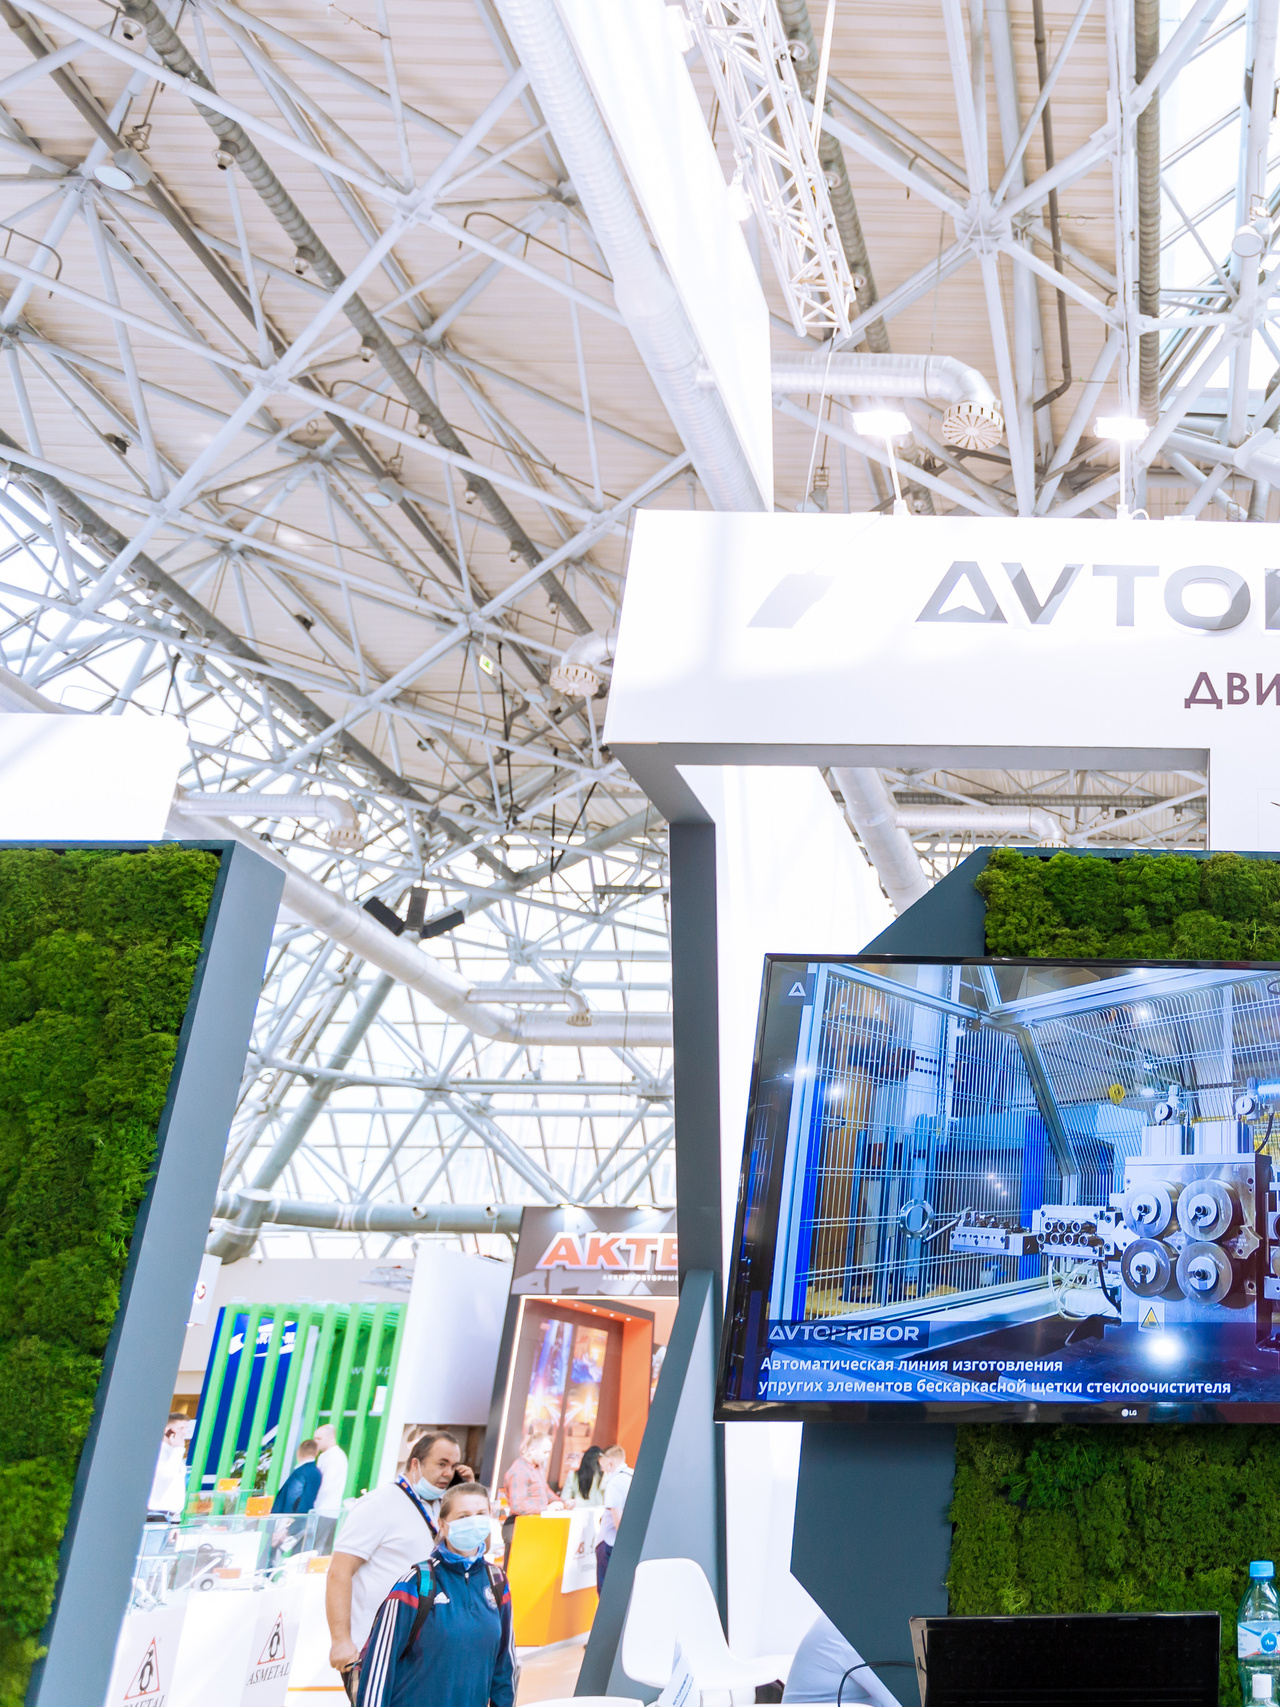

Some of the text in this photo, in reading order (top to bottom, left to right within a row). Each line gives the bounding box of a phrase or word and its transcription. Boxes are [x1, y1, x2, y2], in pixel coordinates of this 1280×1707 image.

[537, 1234, 678, 1268] АКТЕ
[768, 1324, 920, 1342] AVTOPRIBOR
[760, 1357, 1064, 1372] Автоматическая линия изготовления
[757, 1378, 1232, 1396] упругих элементов бескаркасной щетки стеклоочистителя
[246, 1662, 291, 1687] ASMETAL
